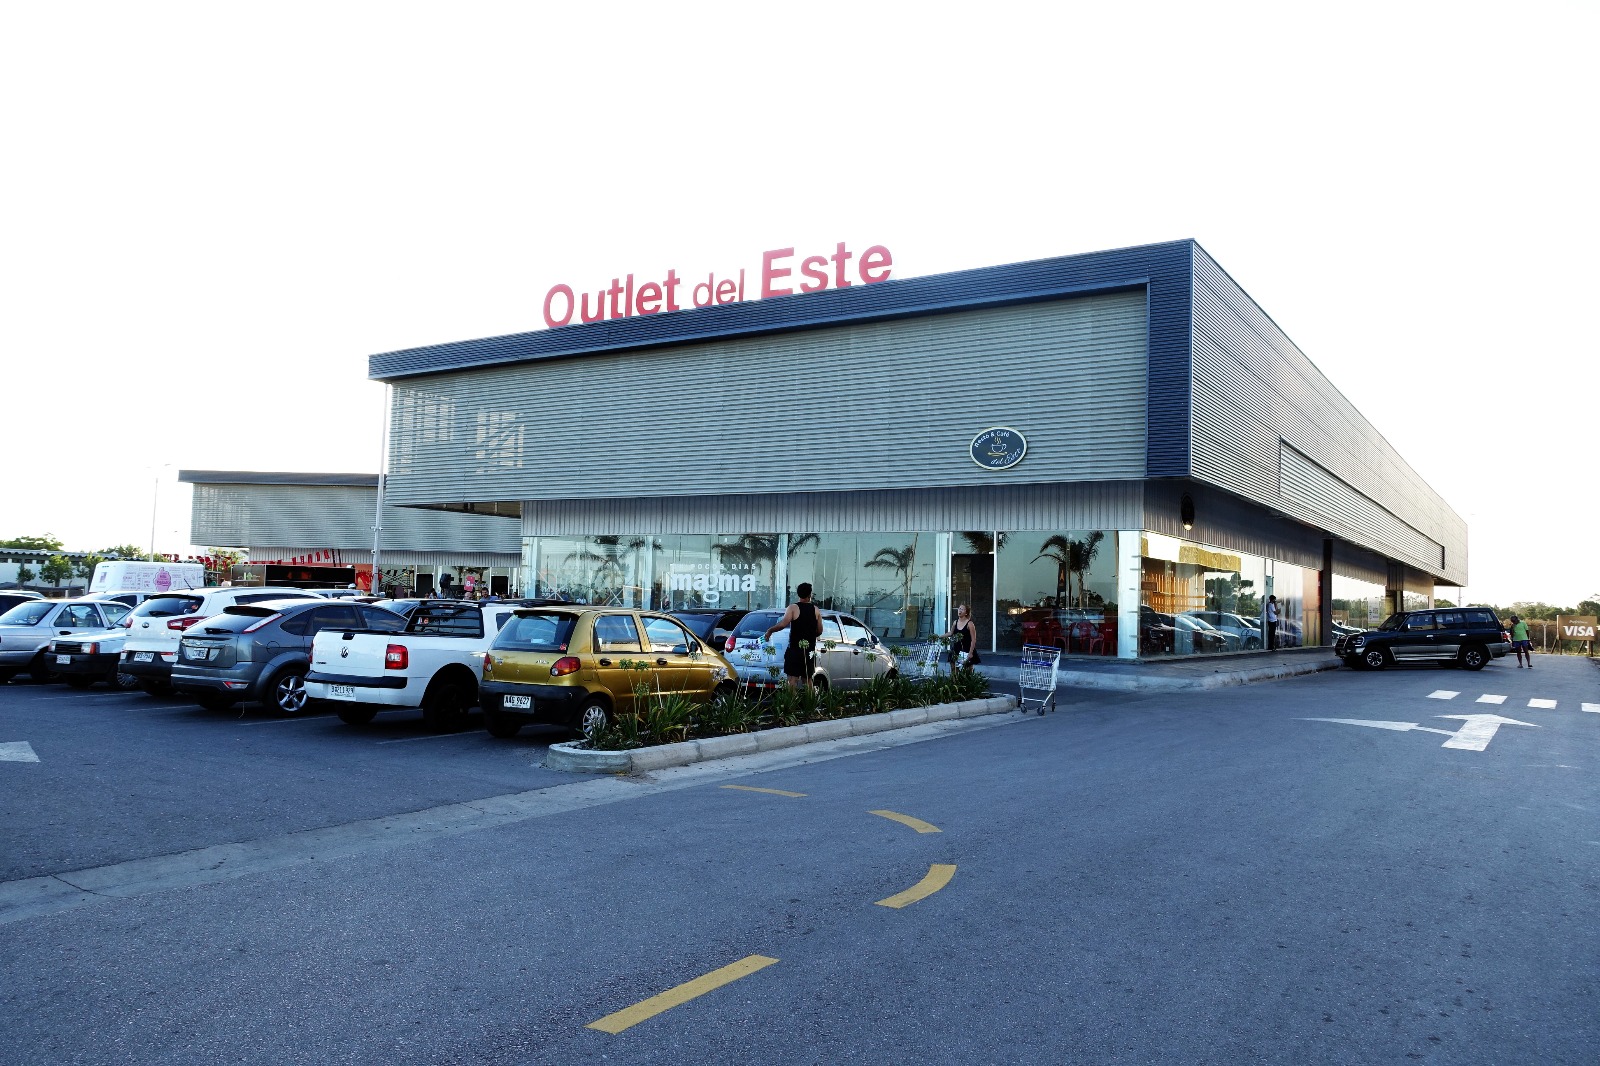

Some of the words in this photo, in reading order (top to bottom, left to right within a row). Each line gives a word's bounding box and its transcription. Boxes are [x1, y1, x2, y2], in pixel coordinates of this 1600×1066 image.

[543, 268, 680, 328] Outlet
[692, 268, 745, 308] del
[761, 242, 893, 299] Este
[996, 430, 1010, 438] Café
[731, 561, 757, 570] DÍAS
[671, 571, 756, 603] magma
[1563, 625, 1595, 636] VISA
